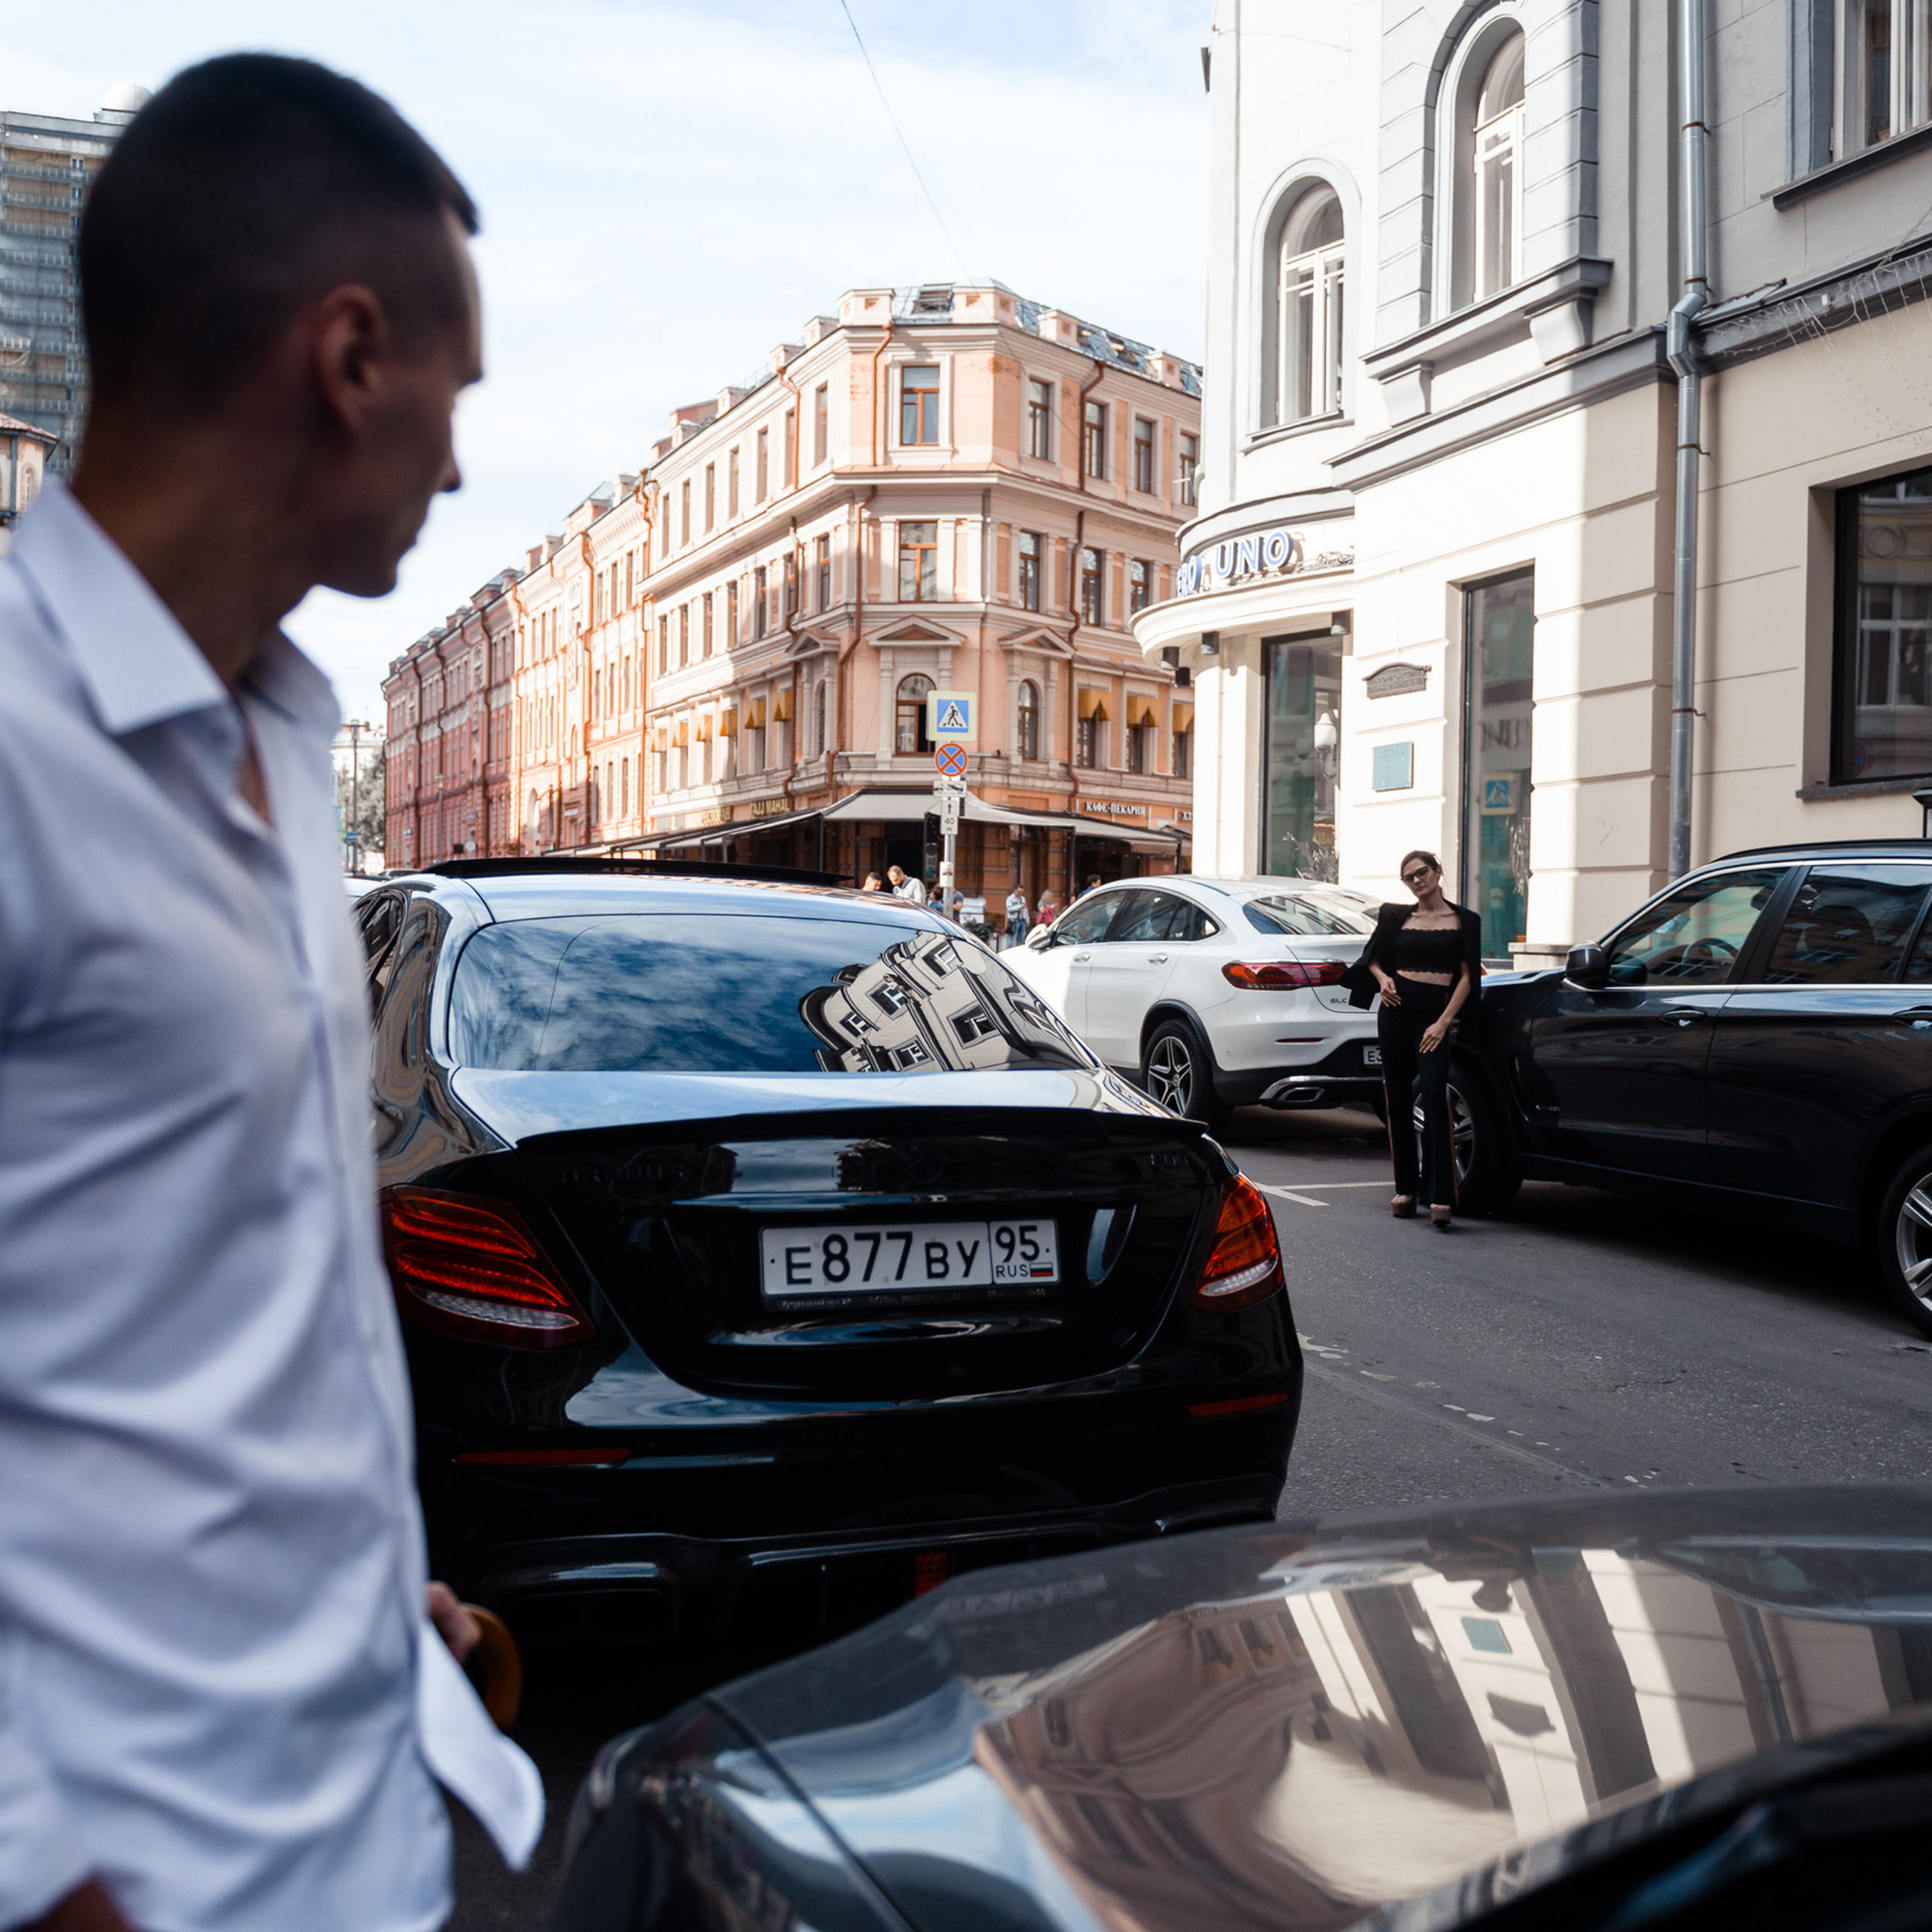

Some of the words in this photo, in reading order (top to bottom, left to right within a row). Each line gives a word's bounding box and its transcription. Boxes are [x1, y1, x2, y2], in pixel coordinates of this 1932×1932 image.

[1215, 530, 1294, 579] UNO
[1085, 801, 1146, 816] КАФЕ-ПЕКАРНЯ
[945, 817, 955, 825] 40
[995, 1225, 1040, 1263] 95
[995, 1263, 1029, 1278] RUS
